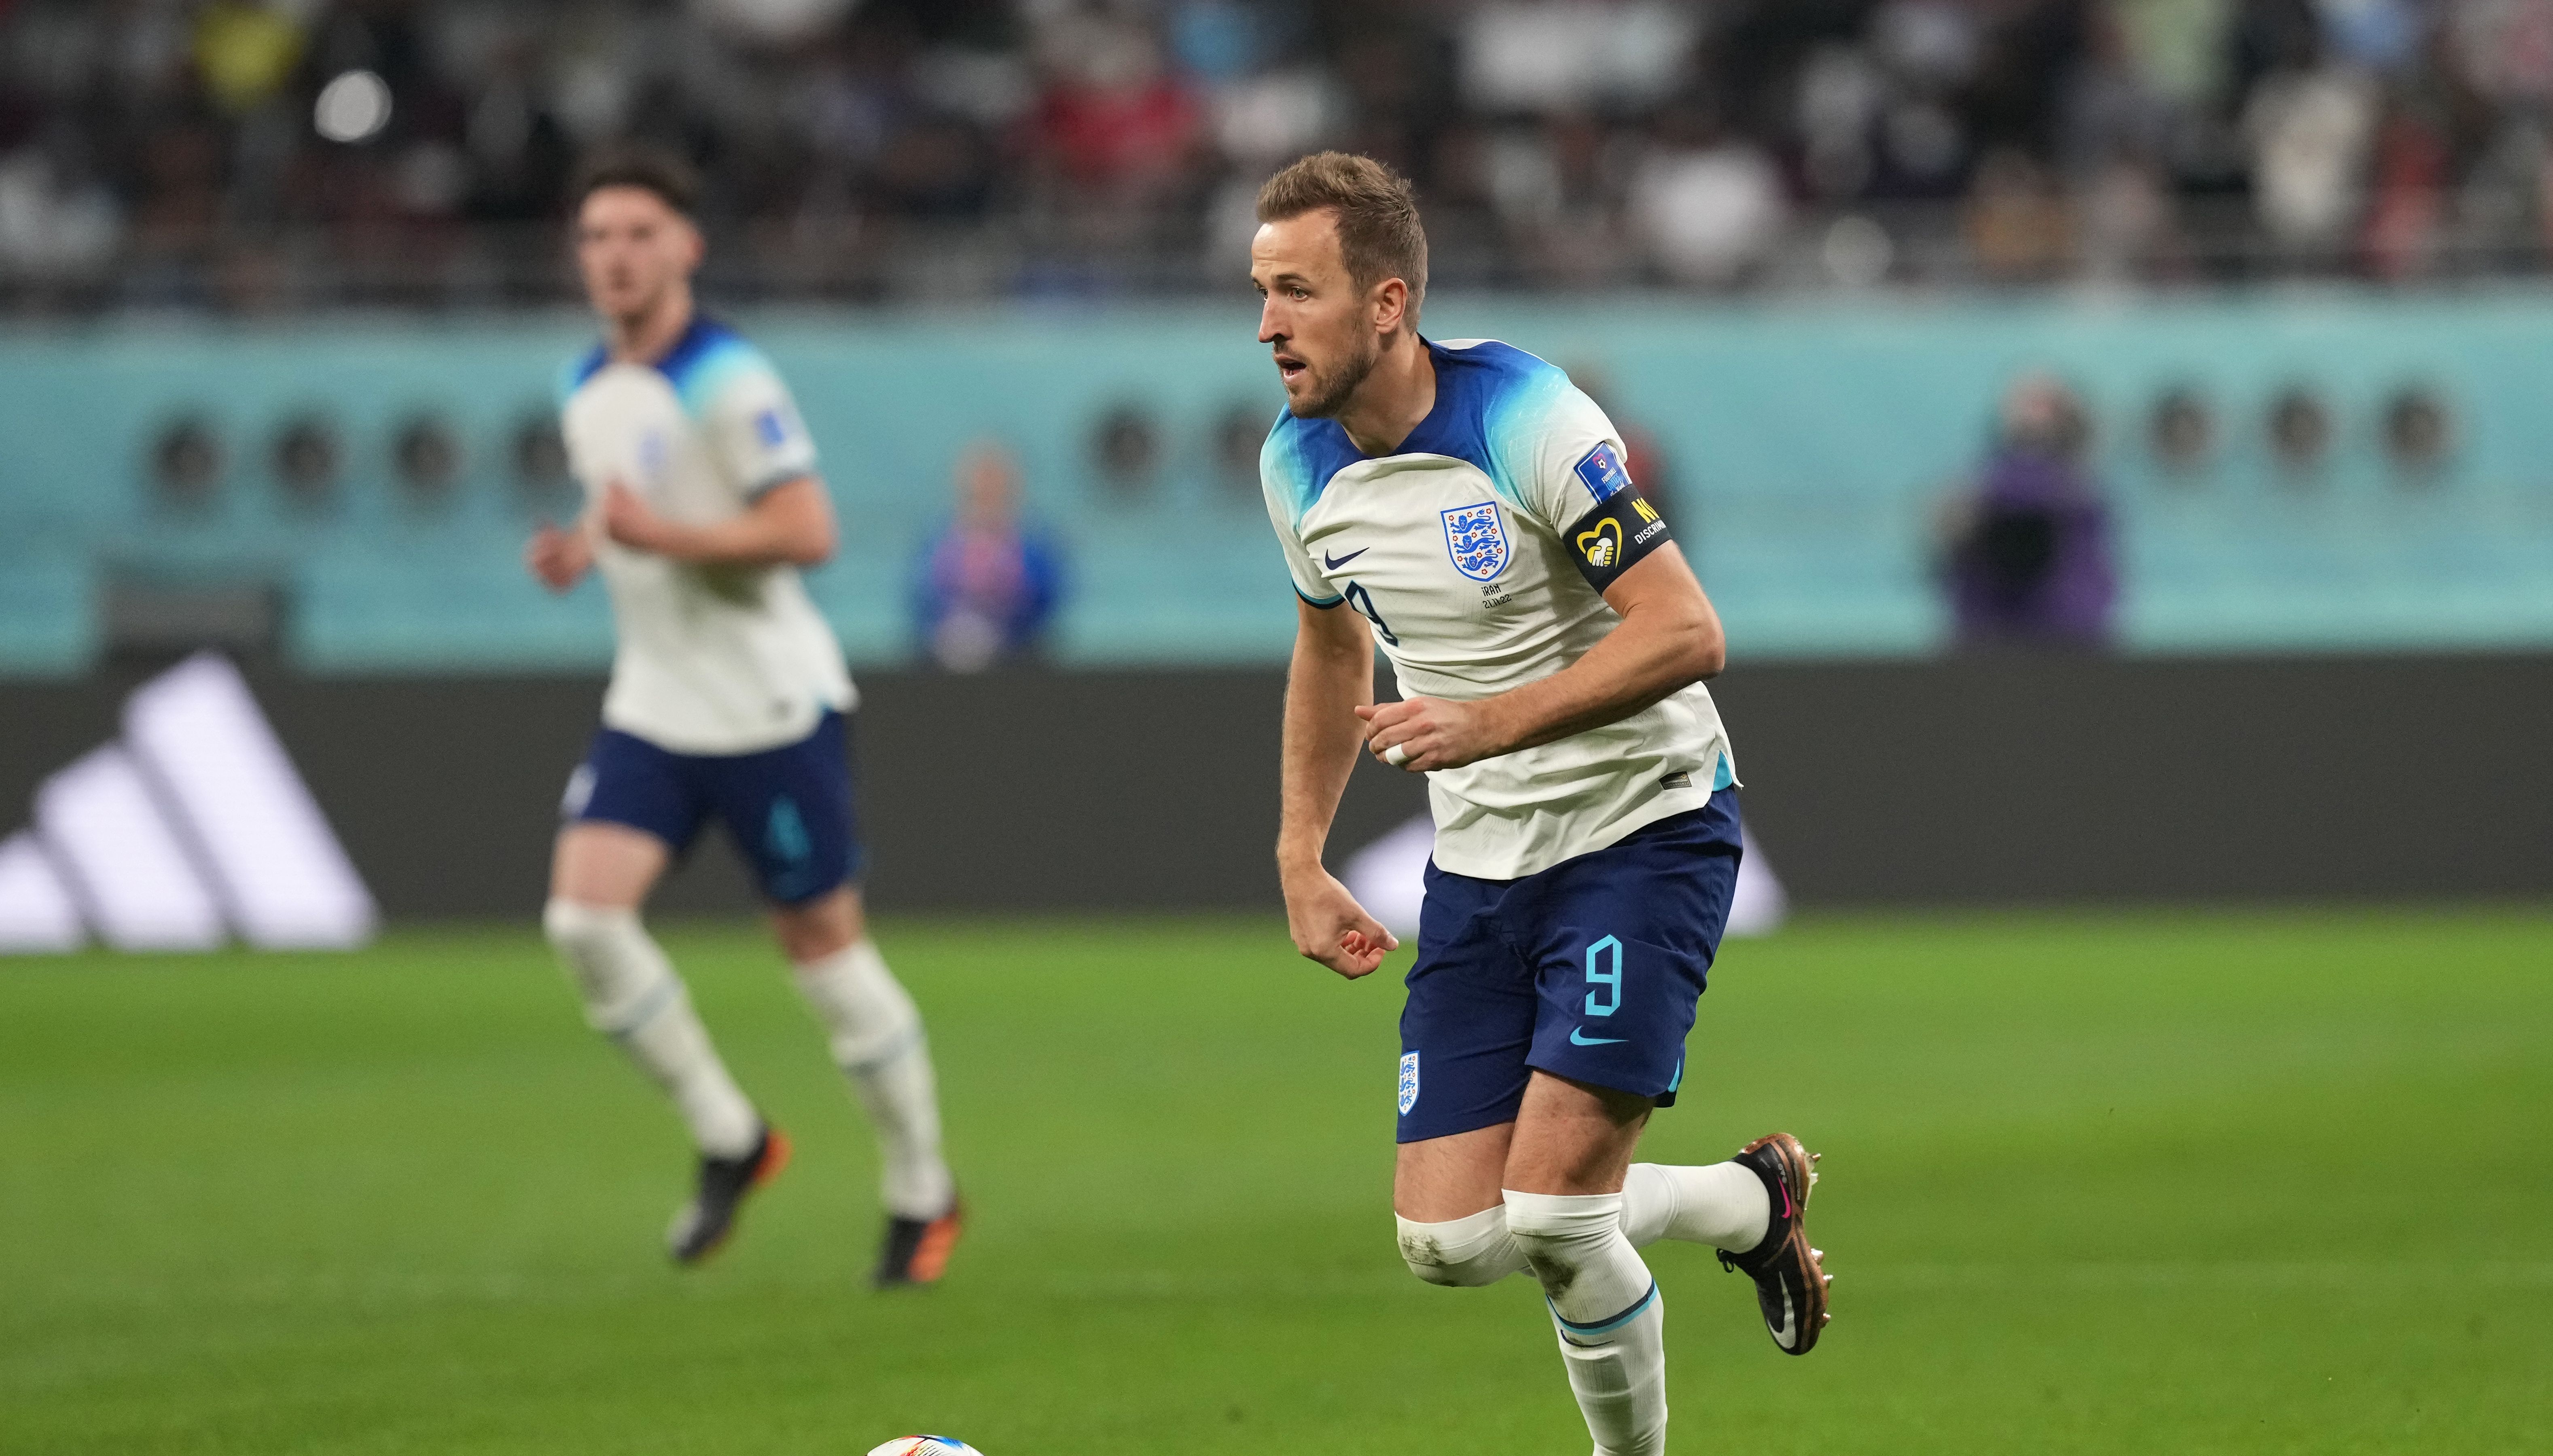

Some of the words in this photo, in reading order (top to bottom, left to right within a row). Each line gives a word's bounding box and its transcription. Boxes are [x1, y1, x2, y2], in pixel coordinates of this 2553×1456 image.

[1601, 467, 1617, 484] FOOTBALL
[1605, 473, 1621, 491] UNITES
[1483, 594, 1512, 609] 21.11.22
[1345, 579, 1398, 647] 9
[1585, 934, 1622, 1016] 9
